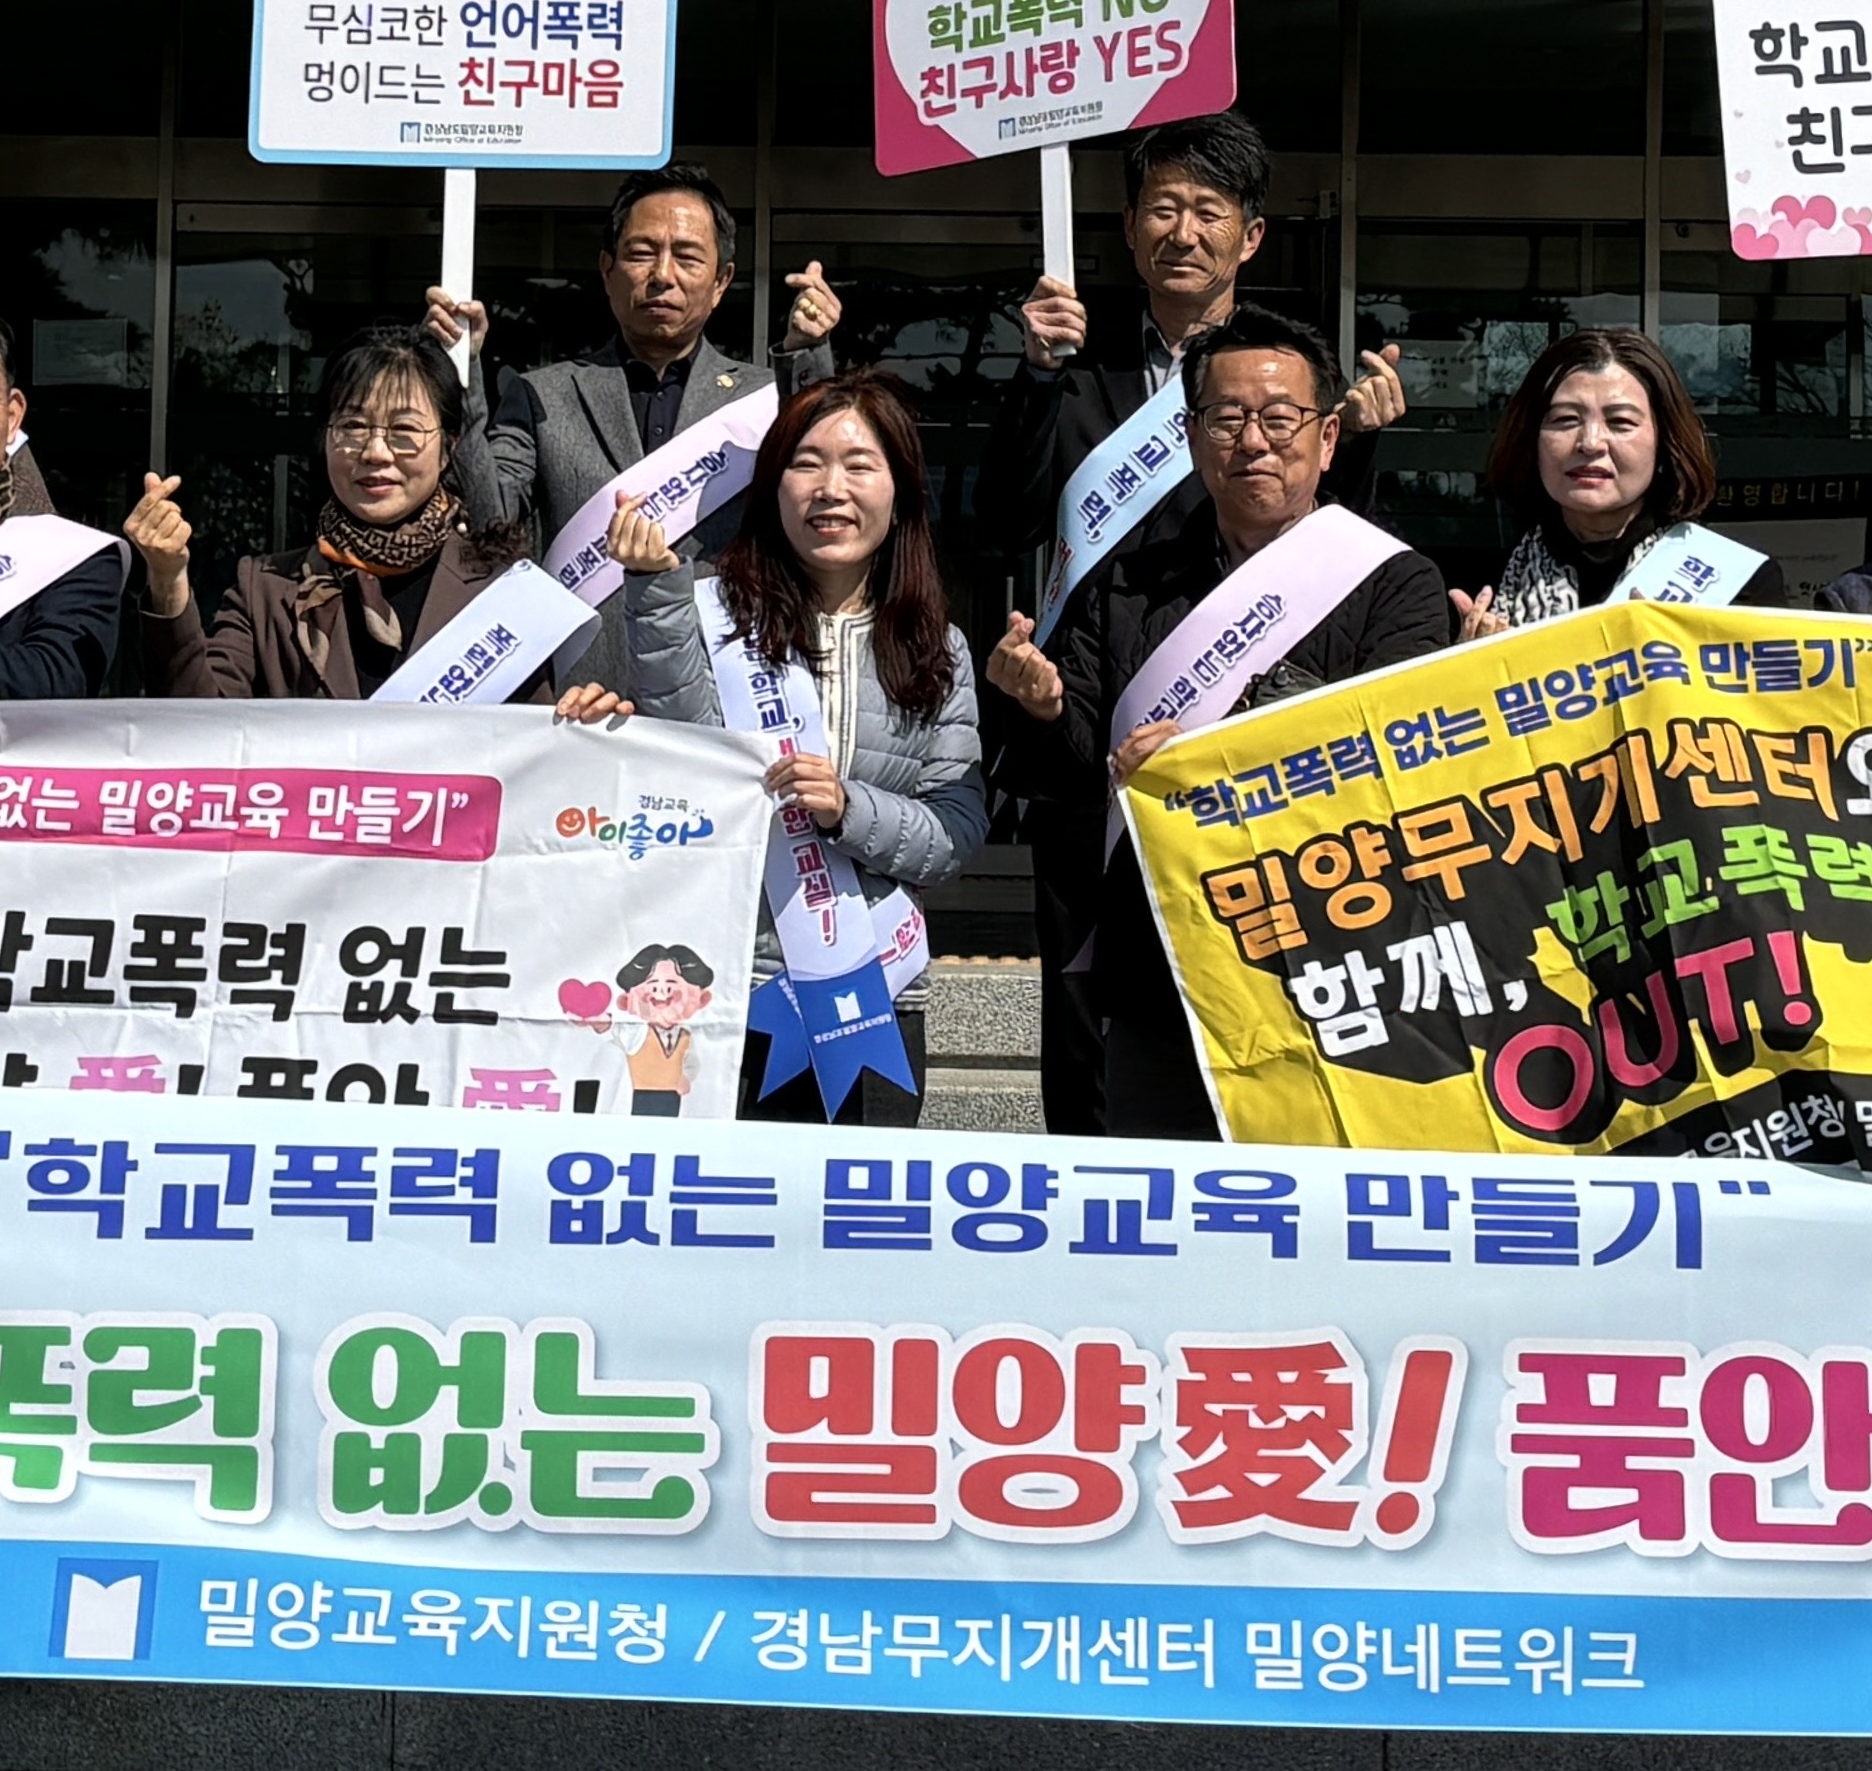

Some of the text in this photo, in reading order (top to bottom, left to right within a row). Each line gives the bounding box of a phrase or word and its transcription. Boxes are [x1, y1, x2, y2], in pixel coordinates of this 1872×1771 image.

[304, 3, 447, 46] 무심코한
[920, 20, 1183, 117] 친구사랑 YES
[304, 57, 624, 108] 멍이드는 친구마음
[1192, 594, 1282, 682] 승자없는
[1384, 705, 1491, 771] 없는
[1494, 640, 1689, 735] 밀양교육
[99, 780, 289, 840] 밀양교육
[556, 806, 714, 861] 아이좋아
[339, 925, 511, 1025] 없는
[1289, 921, 1529, 1057] 함께,
[1493, 931, 1813, 1131] OUT!
[548, 1150, 779, 1248] 없는
[823, 1158, 1300, 1260] 밀양교육
[328, 1326, 706, 1519] 없는
[763, 1335, 1147, 1528] 밀양
[1171, 1340, 1454, 1535] 愛!
[199, 1577, 668, 1665] 밀양교육지원청
[751, 1608, 1217, 1690] 경남무지개센터
[1246, 1620, 1645, 1696] 밀양네트워크
